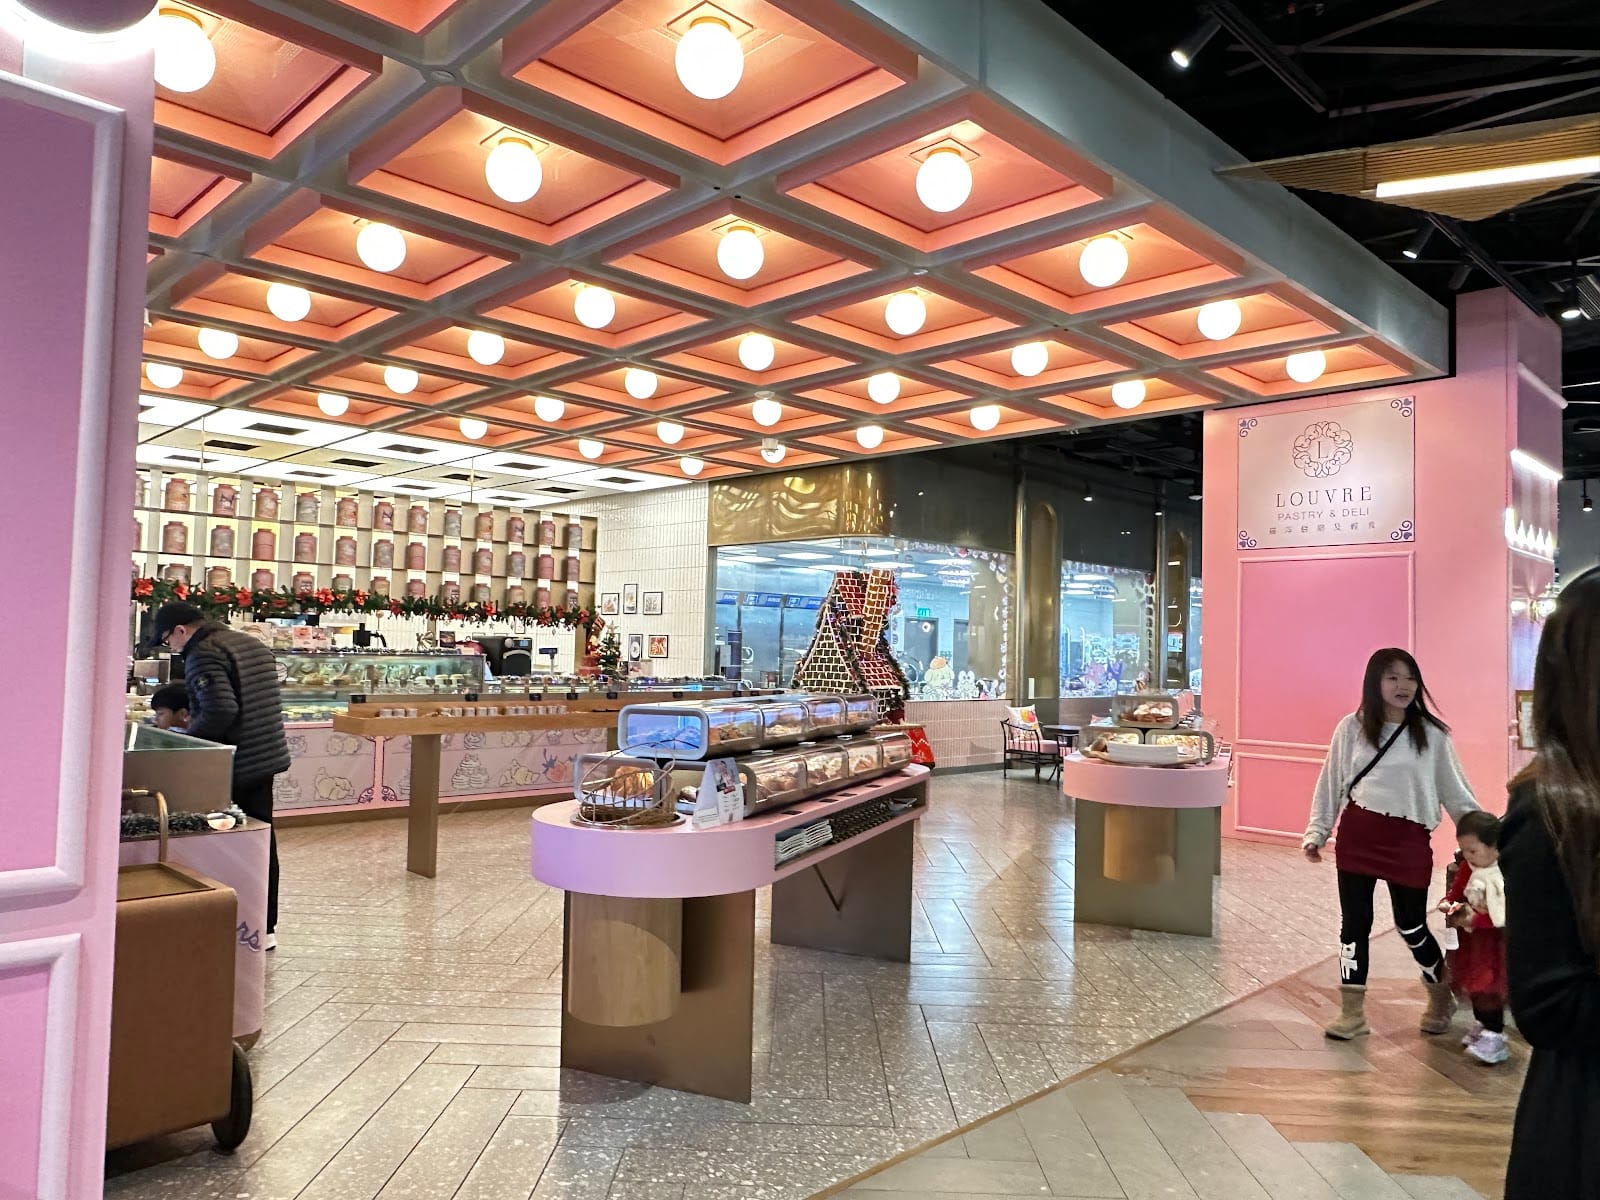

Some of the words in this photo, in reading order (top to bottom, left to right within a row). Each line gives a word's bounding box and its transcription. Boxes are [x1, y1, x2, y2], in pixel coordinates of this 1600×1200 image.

[1317, 441, 1329, 459] L
[1276, 486, 1372, 508] LOUVRE
[1277, 511, 1323, 521] PASTRY
[1329, 509, 1336, 518] &
[1342, 507, 1369, 517] DELI
